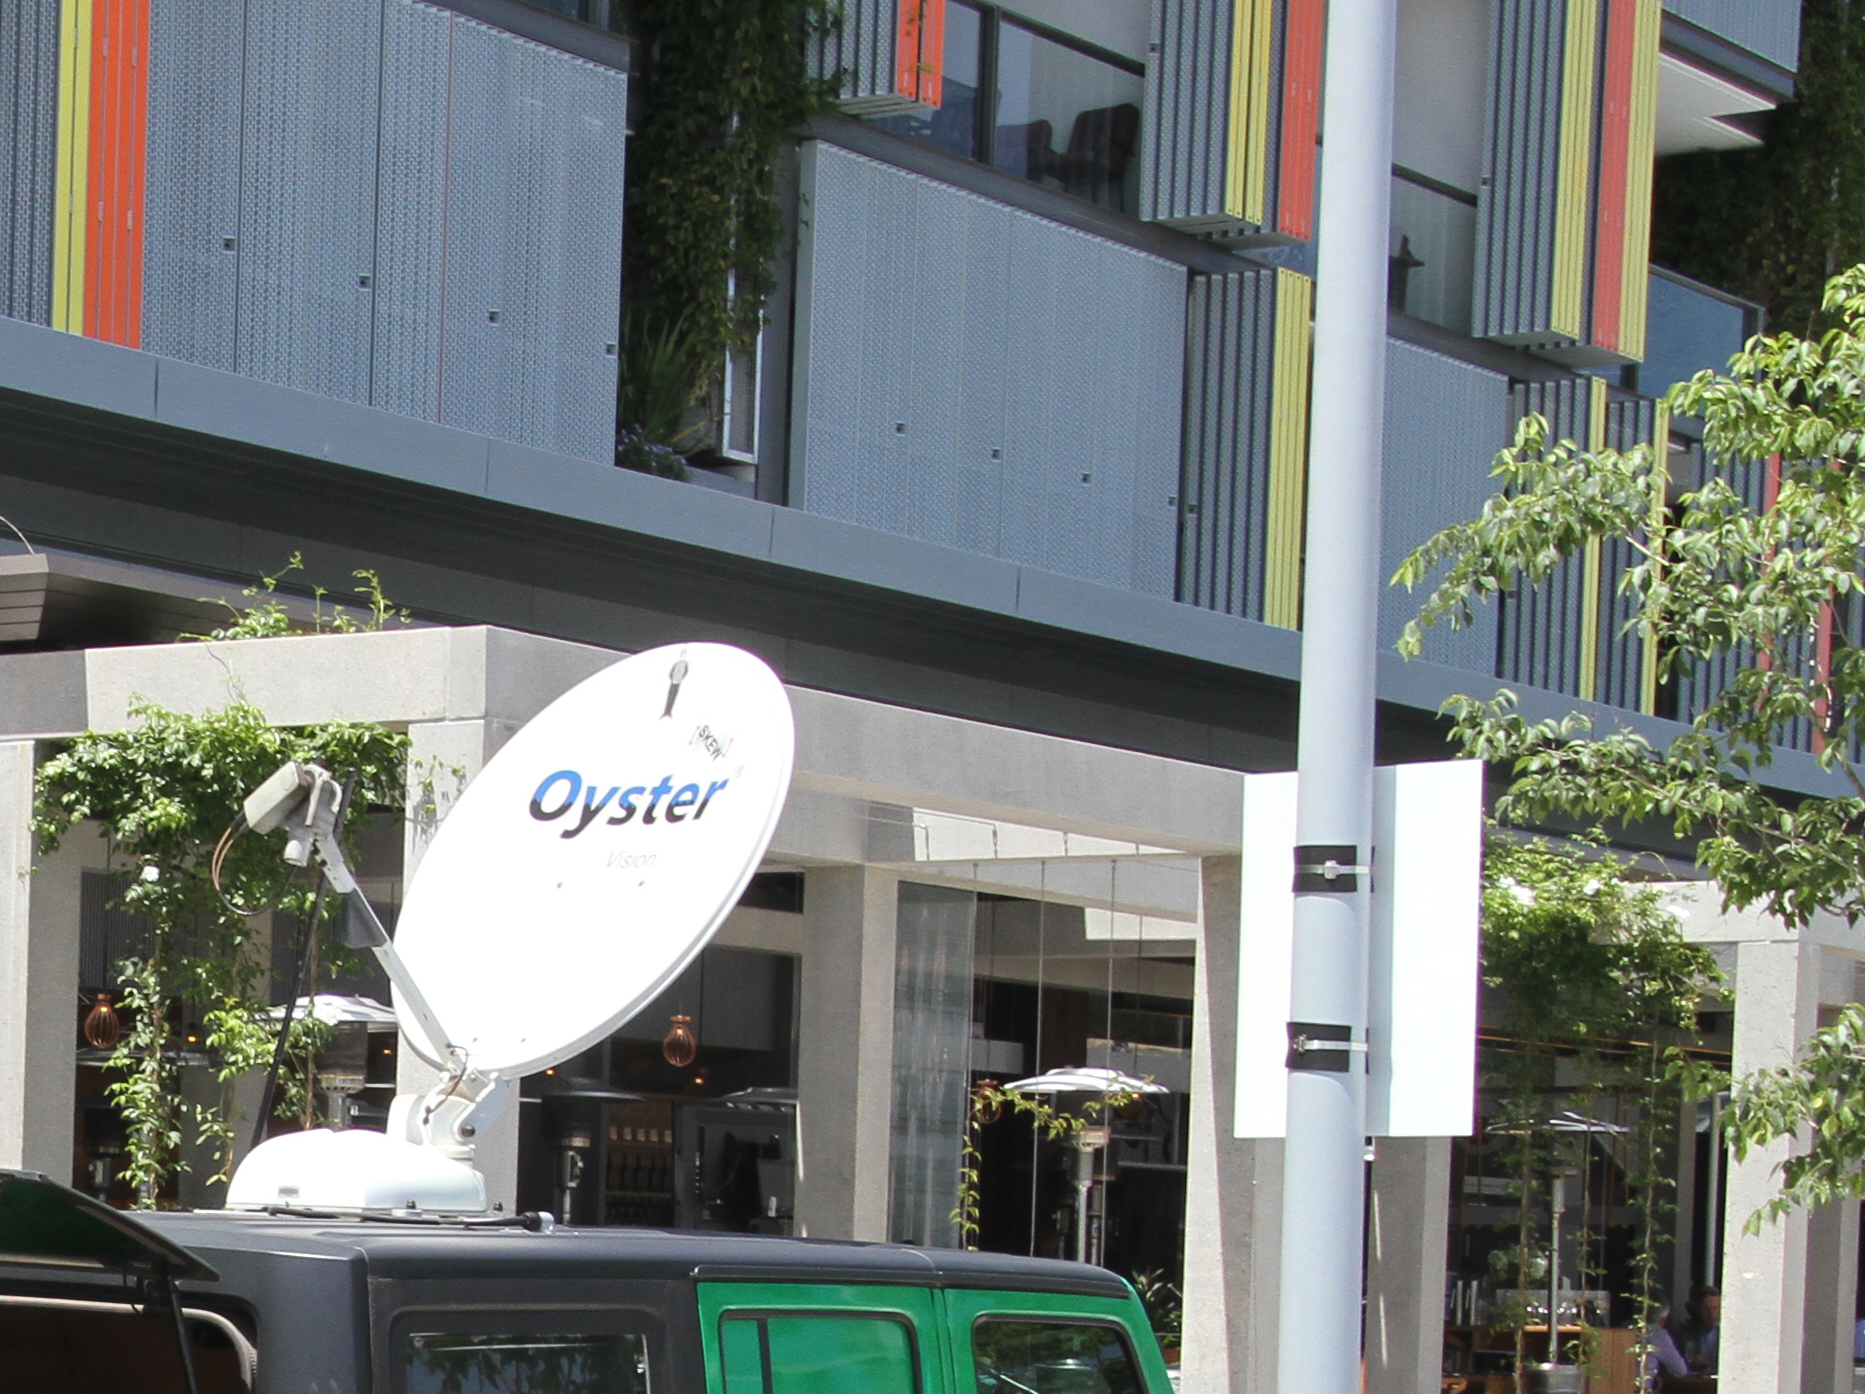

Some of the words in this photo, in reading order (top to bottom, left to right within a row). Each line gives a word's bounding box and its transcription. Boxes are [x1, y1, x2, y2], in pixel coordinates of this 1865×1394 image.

[698, 724, 723, 762] SKEW
[528, 769, 730, 840] Oyster
[605, 850, 657, 869] Vision
